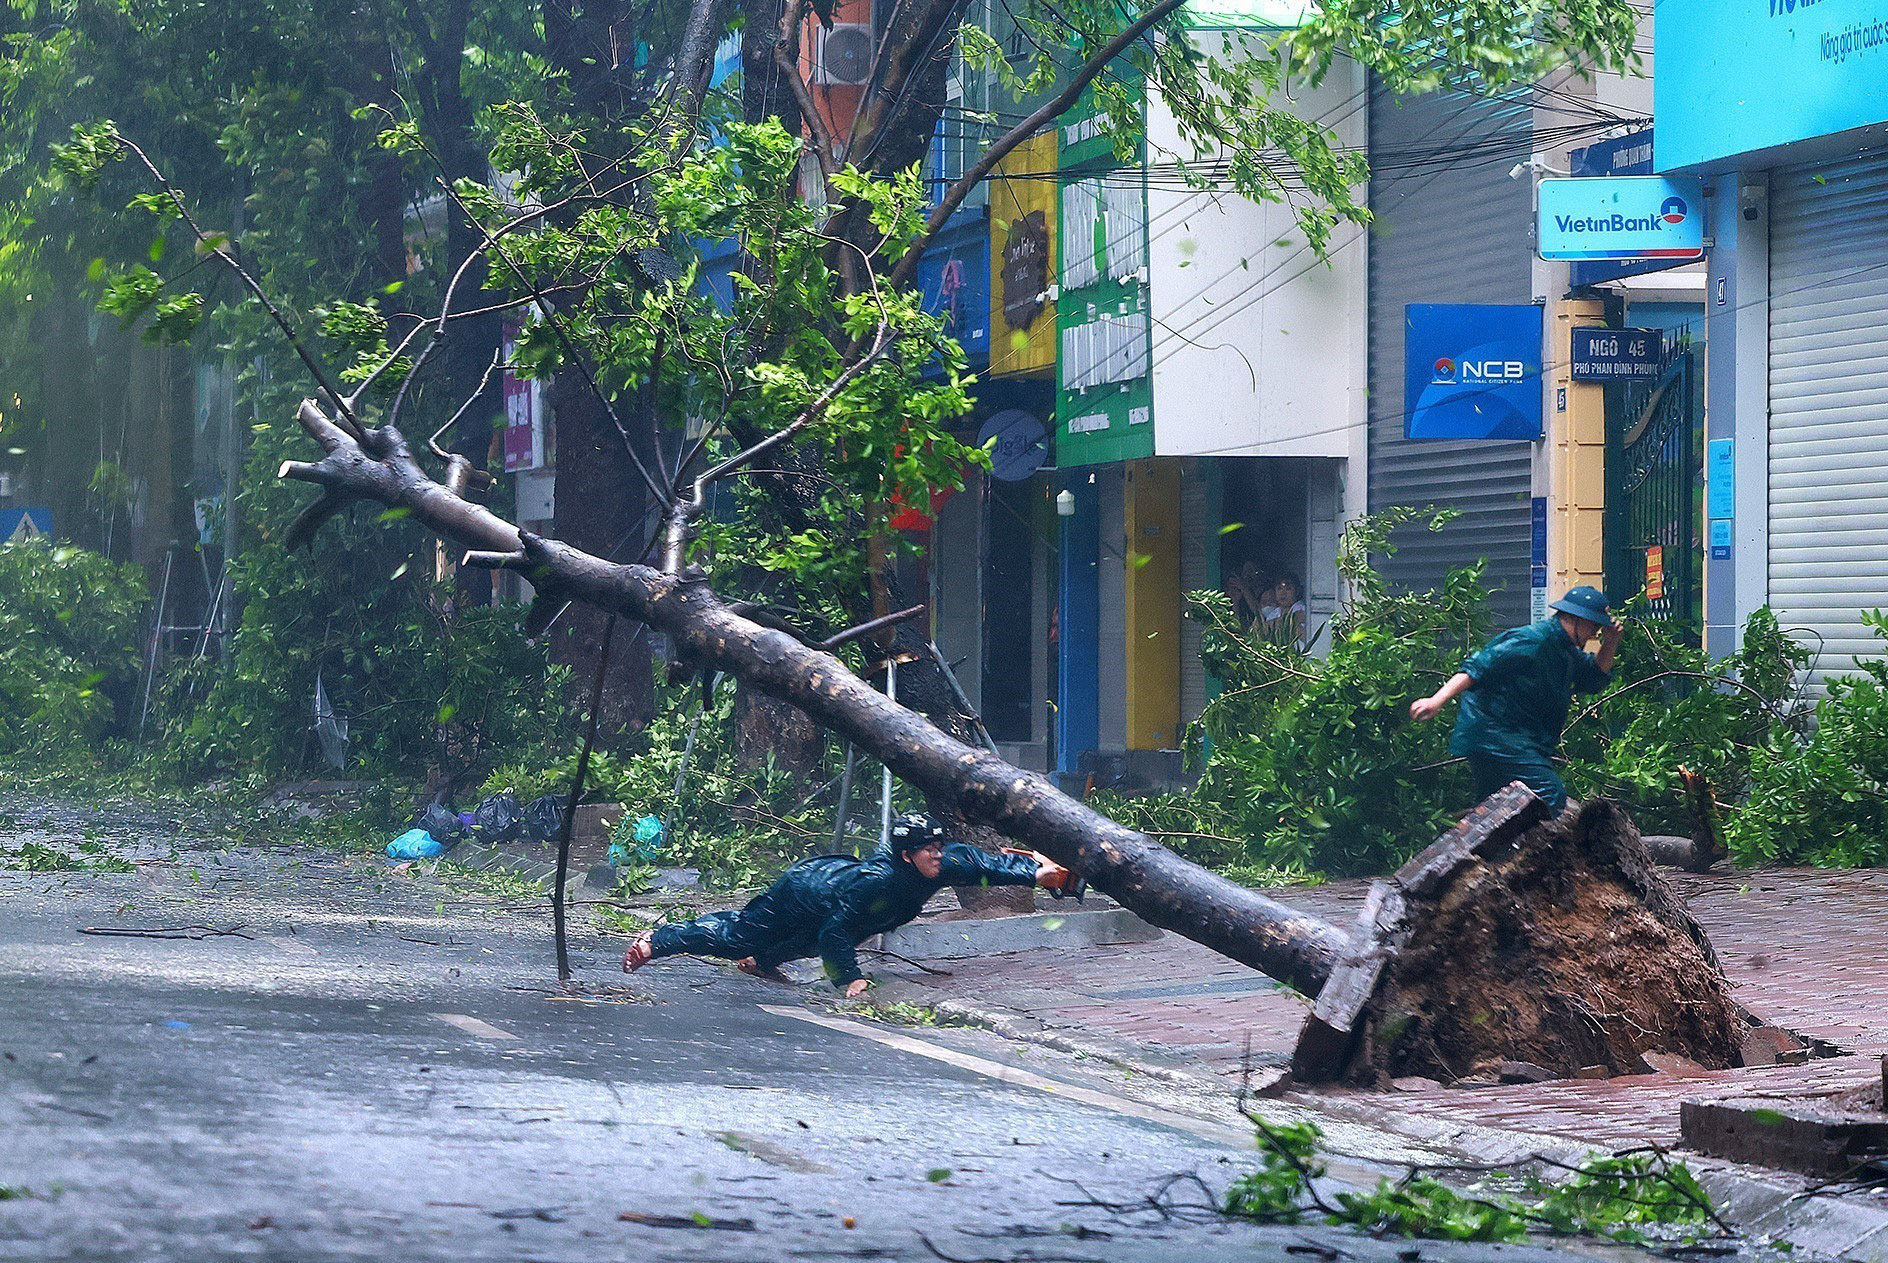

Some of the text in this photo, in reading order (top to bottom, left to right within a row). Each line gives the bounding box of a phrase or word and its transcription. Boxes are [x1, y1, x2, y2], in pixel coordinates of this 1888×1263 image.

[1863, 17, 1883, 53] cuộc
[1554, 213, 1663, 233] VietinBank
[1628, 339, 1646, 357] 45
[1462, 361, 1524, 378] NCB
[1591, 362, 1612, 374] PHAN
